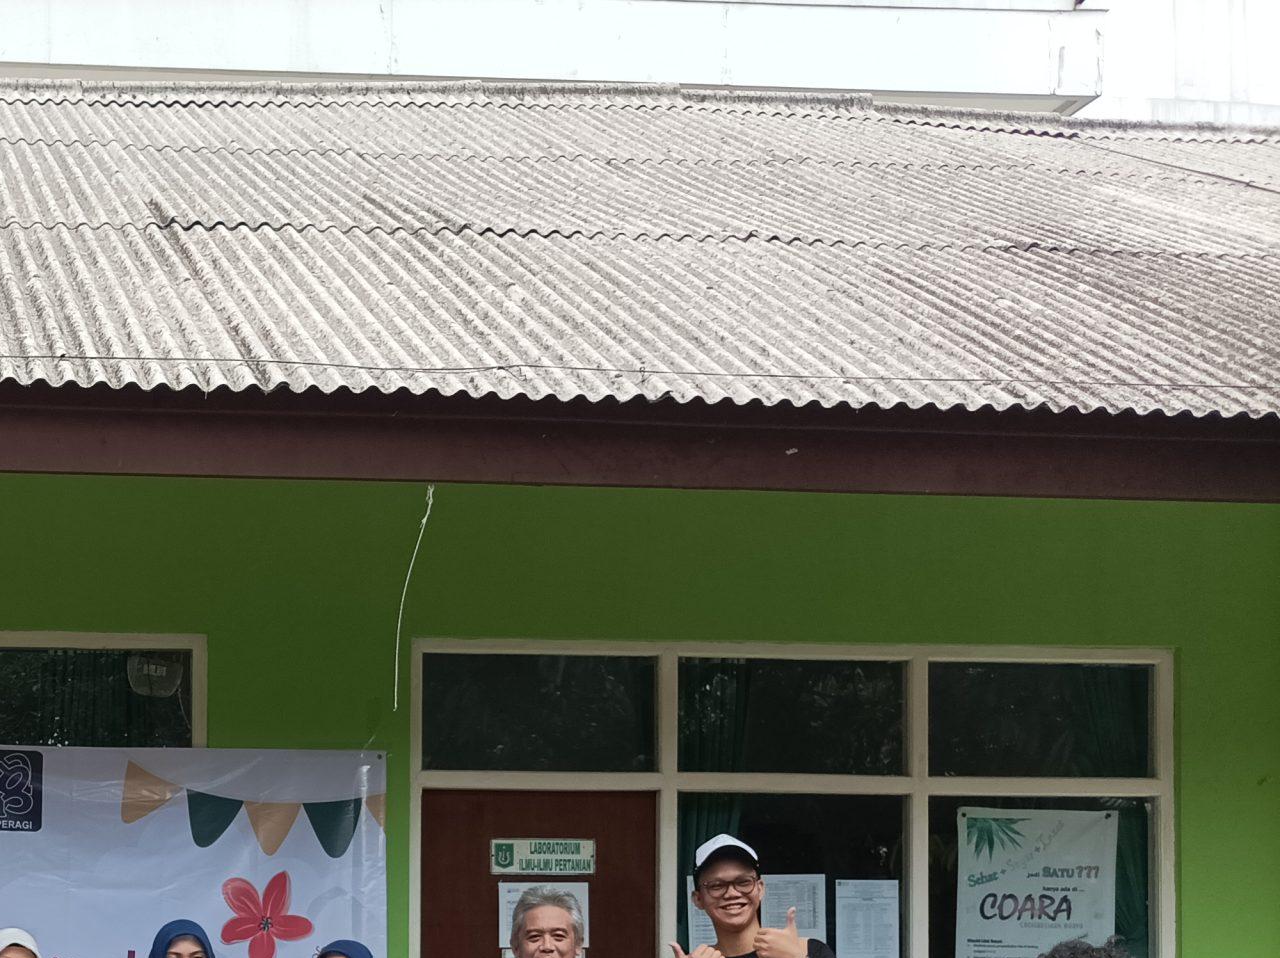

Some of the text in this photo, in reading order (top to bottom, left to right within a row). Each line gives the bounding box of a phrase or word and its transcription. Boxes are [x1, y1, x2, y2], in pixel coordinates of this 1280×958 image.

[529, 842, 581, 855] LABORATORIUM
[555, 859, 591, 872] PERTANIAN
[979, 892, 1072, 921] COARA
